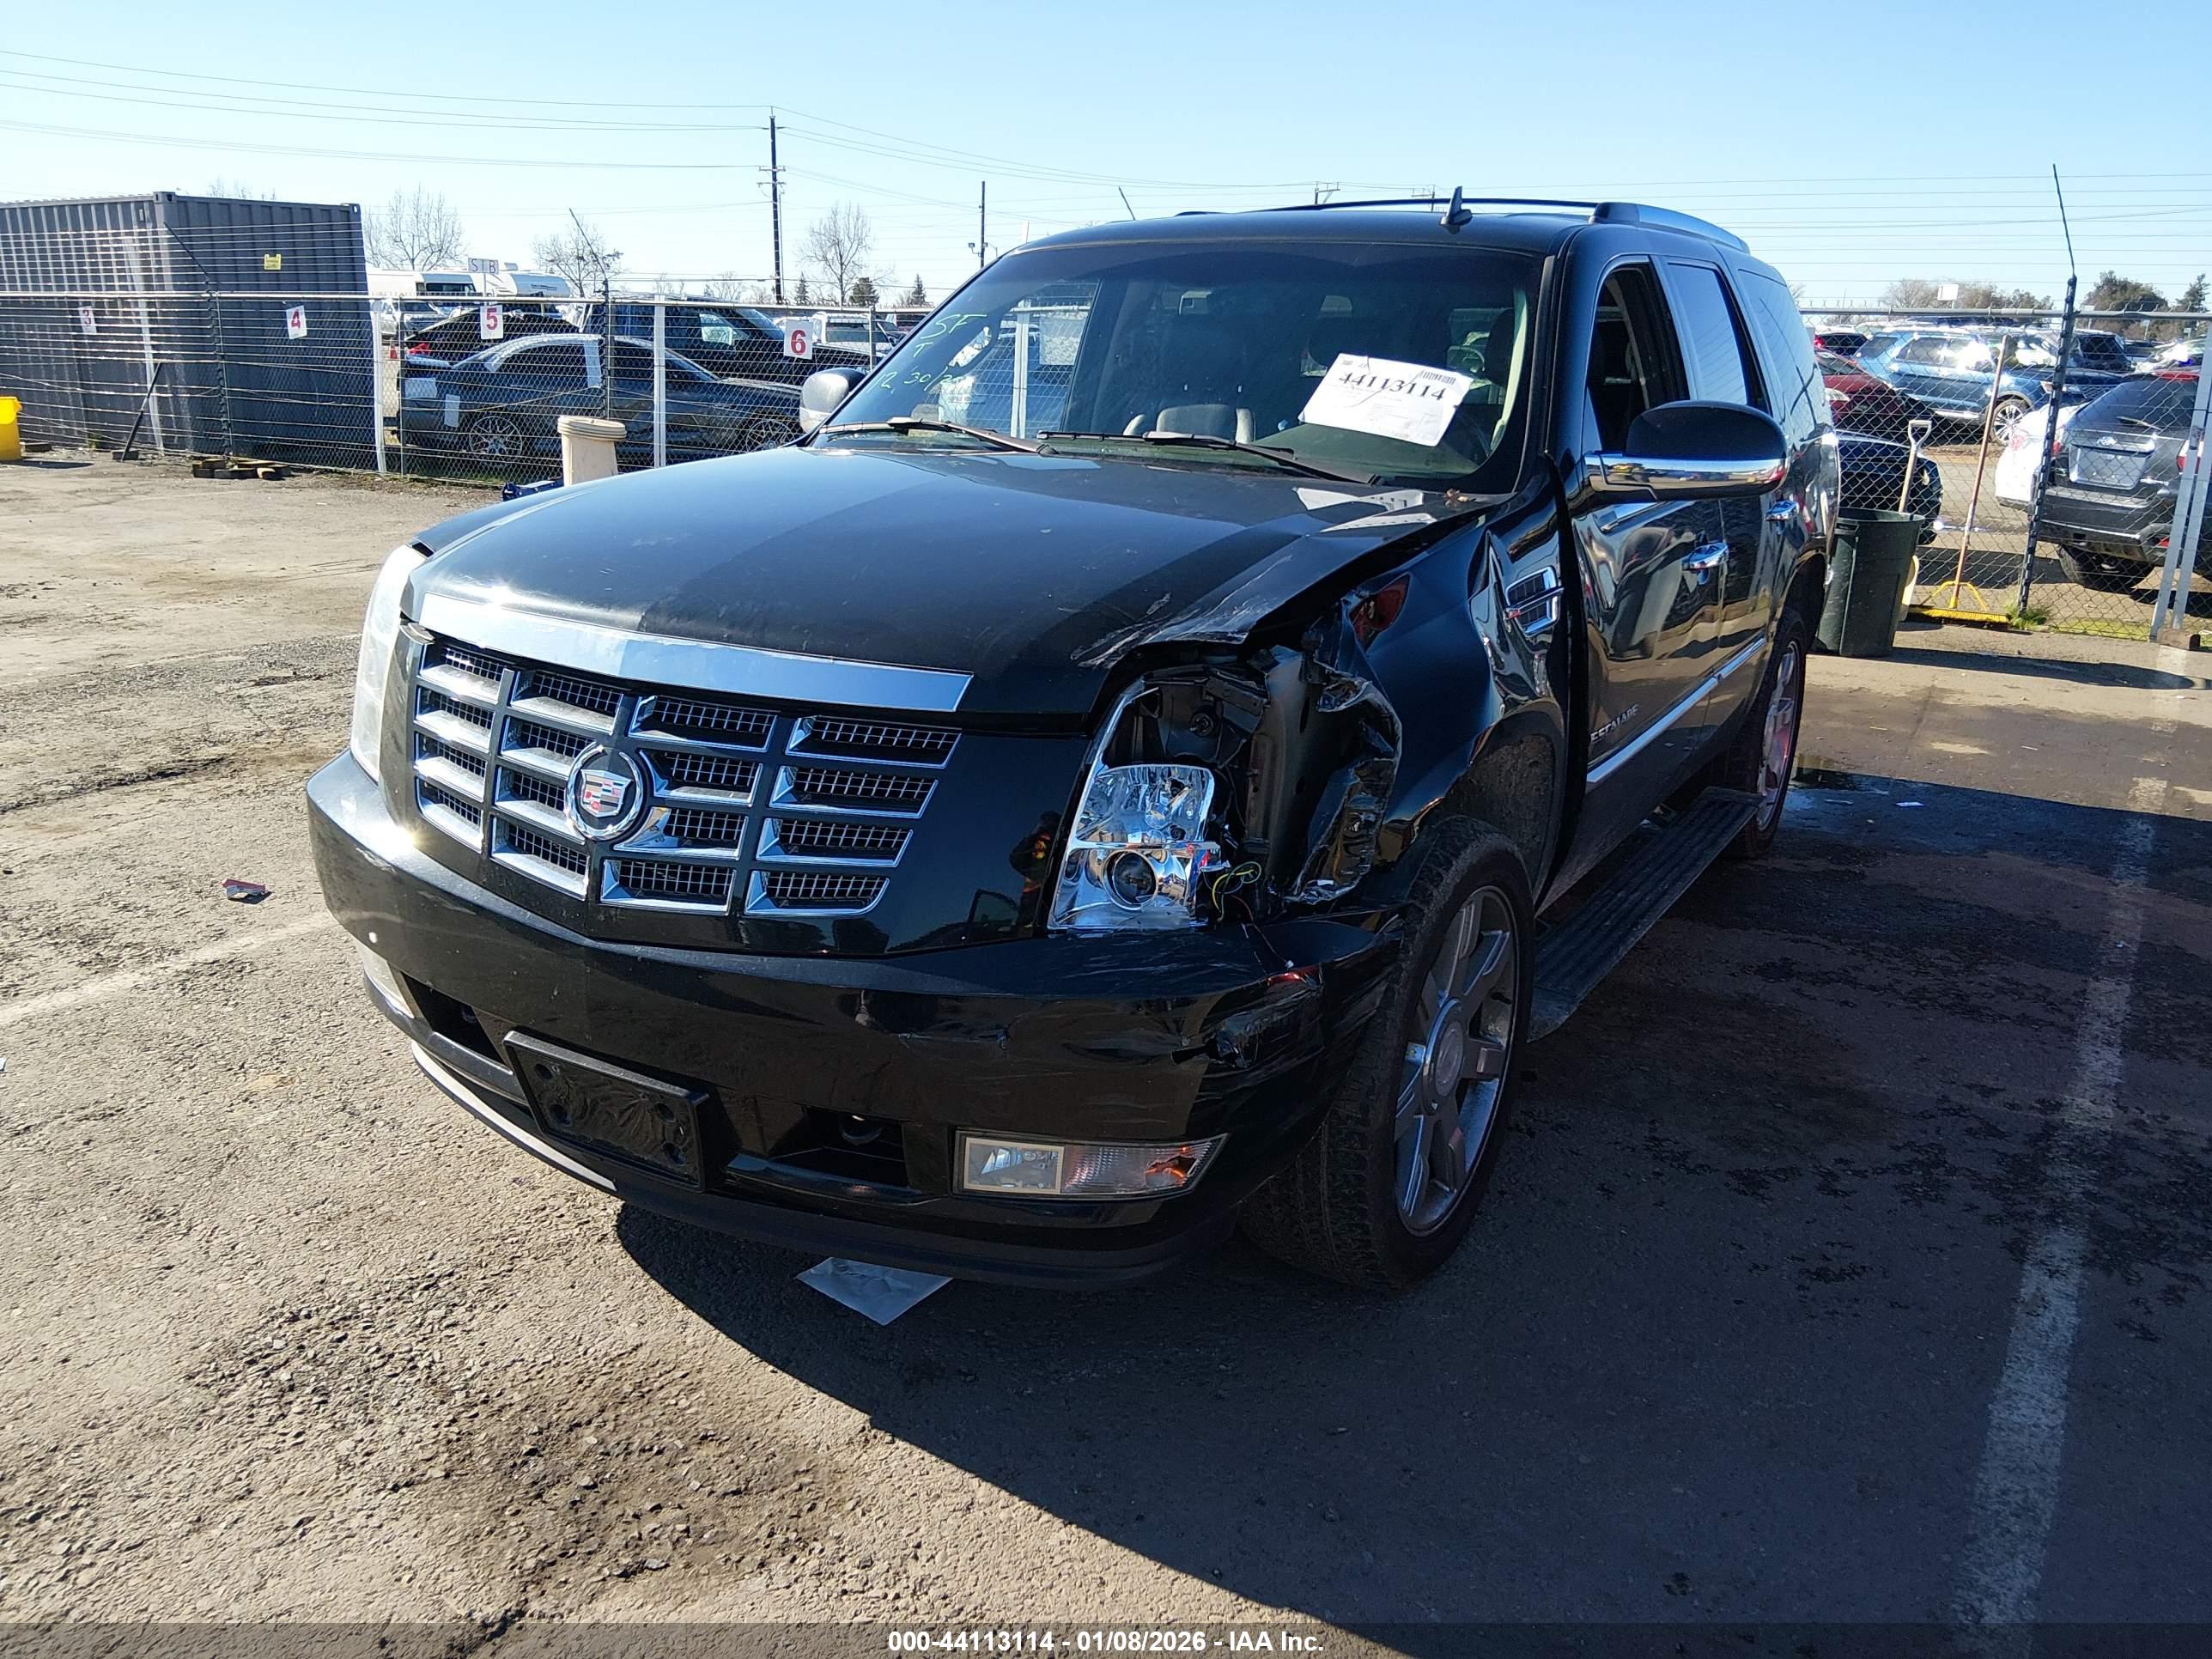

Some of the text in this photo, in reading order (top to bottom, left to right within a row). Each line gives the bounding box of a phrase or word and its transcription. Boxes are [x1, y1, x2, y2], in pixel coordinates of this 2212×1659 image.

[82, 309, 92, 325] 3
[291, 310, 301, 330] 4
[486, 307, 498, 331] 5
[791, 329, 806, 356] 6
[1339, 372, 1447, 401] 44113114
